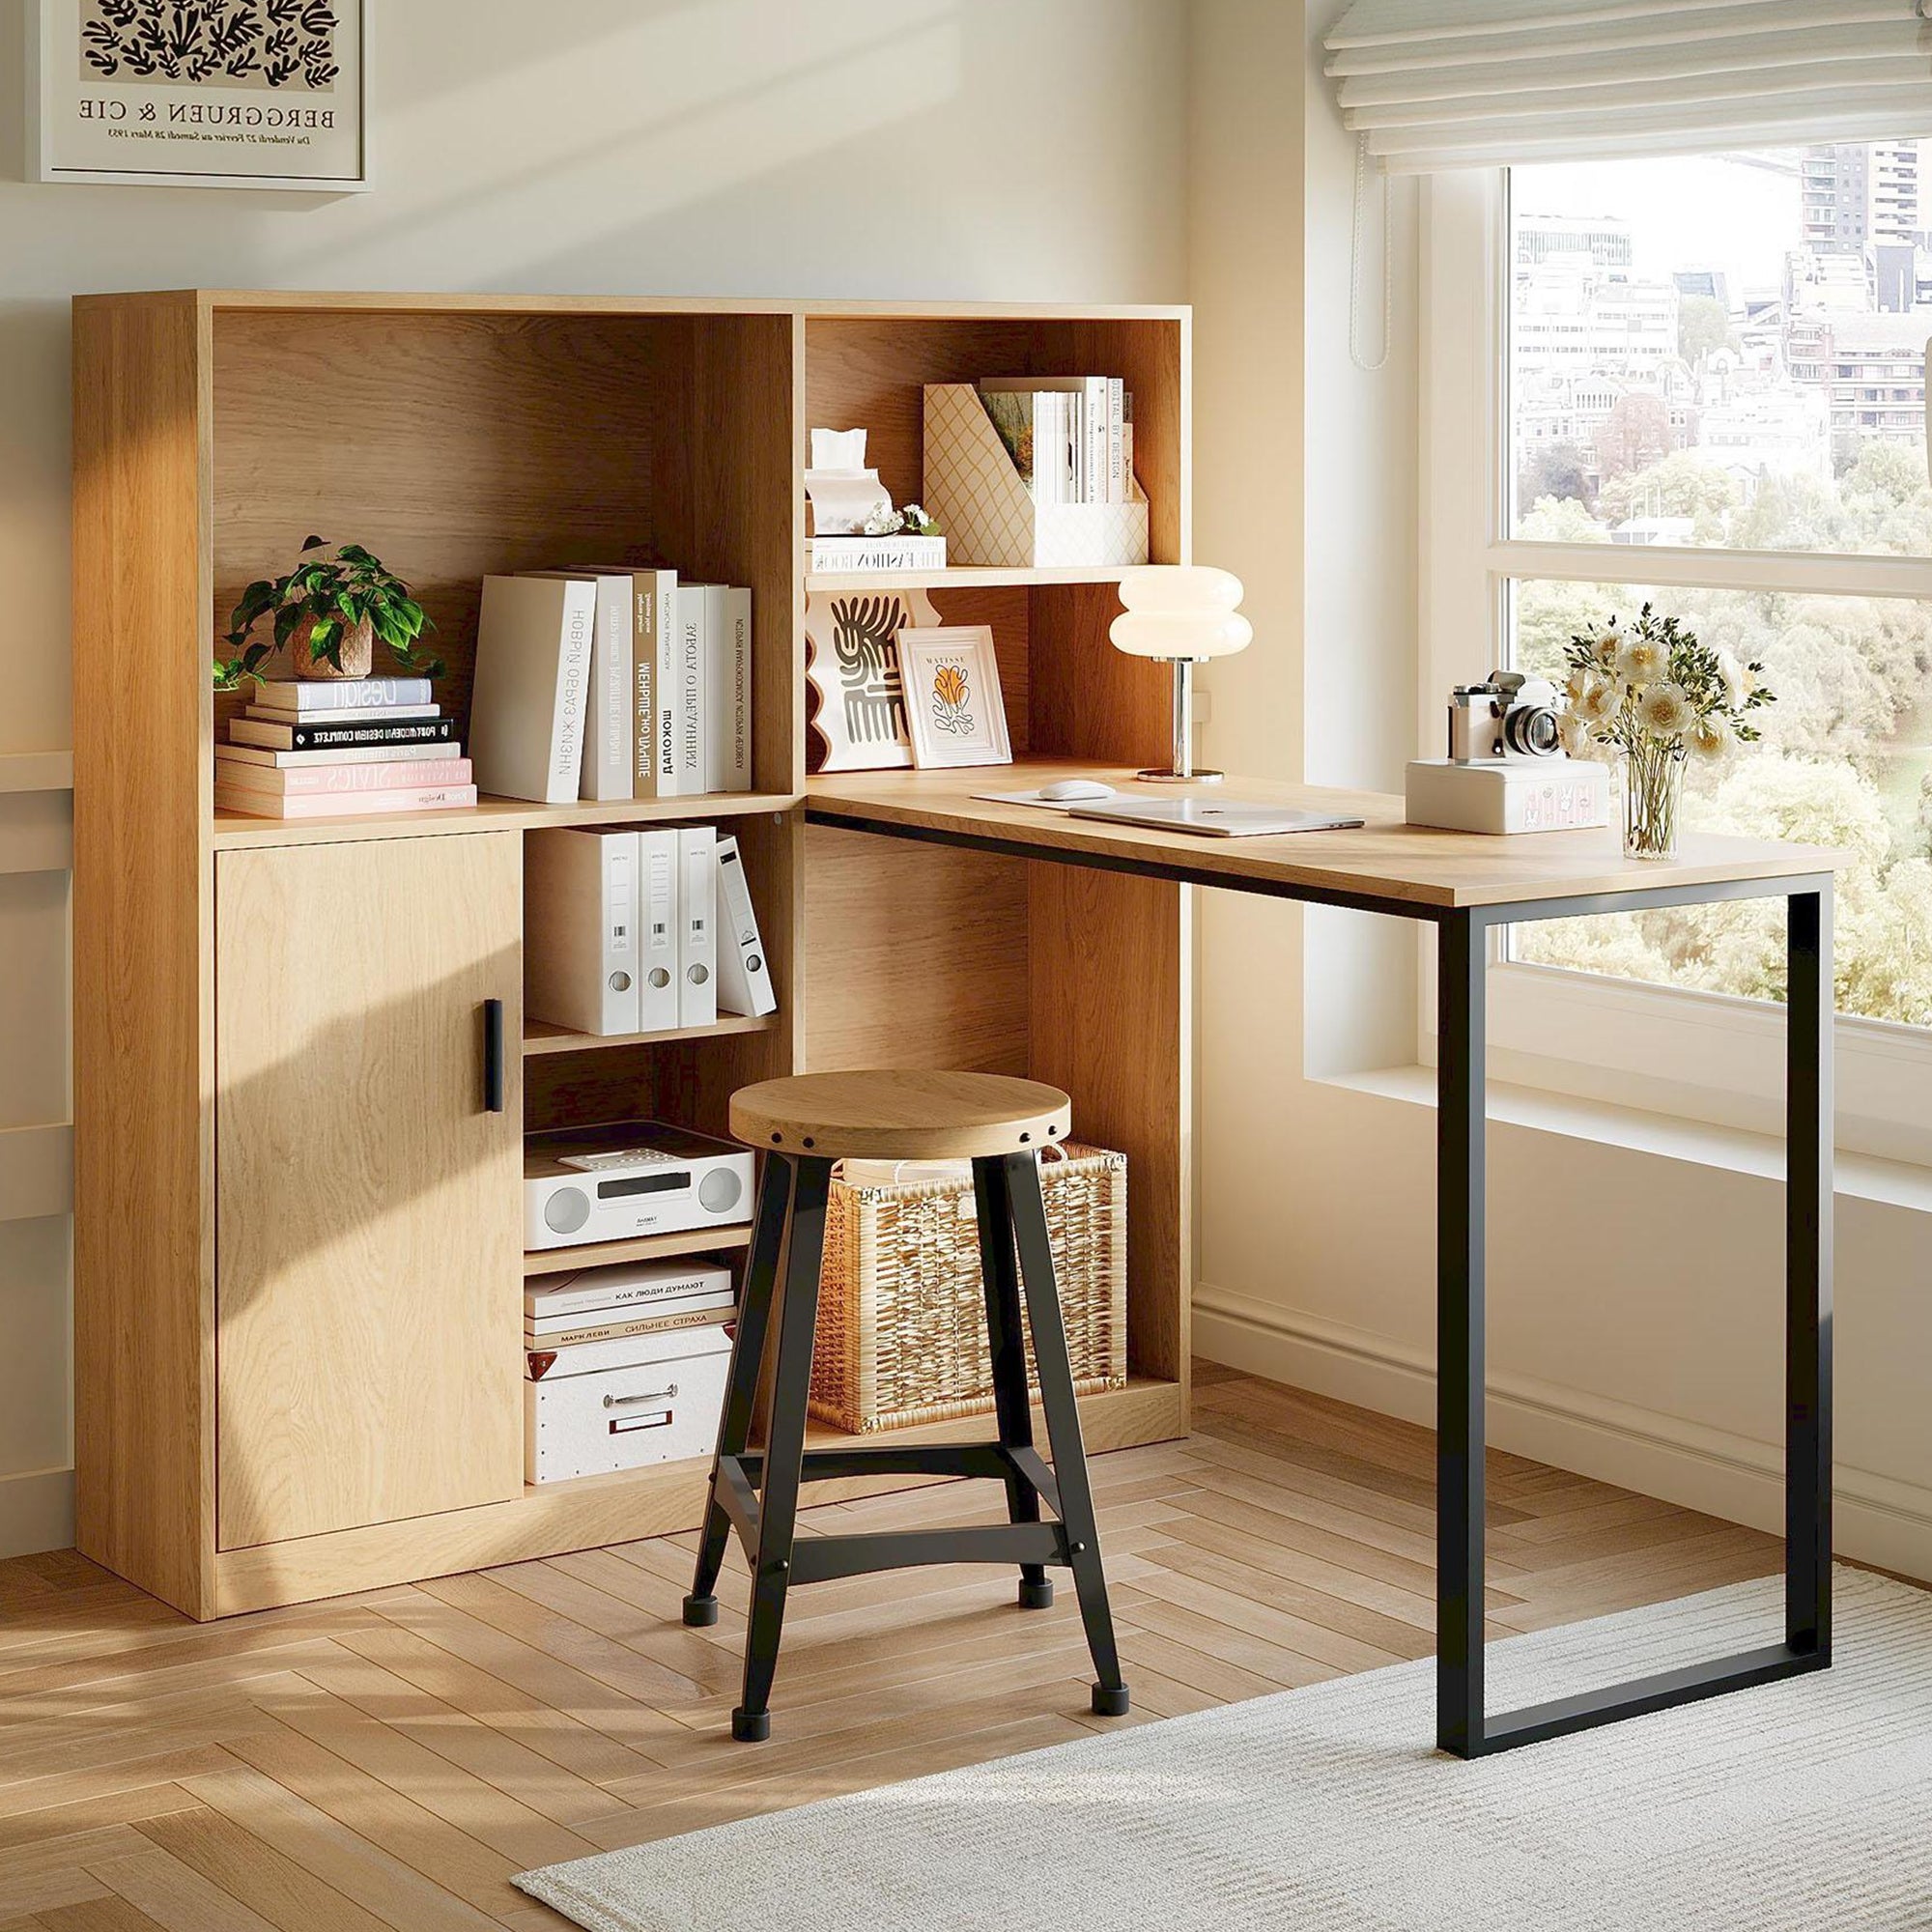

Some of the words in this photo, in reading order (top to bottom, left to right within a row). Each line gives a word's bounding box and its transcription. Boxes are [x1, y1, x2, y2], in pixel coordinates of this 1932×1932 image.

[1112, 442, 1121, 479] DESIGN
[614, 1291, 634, 1300] КАК
[635, 1288, 664, 1298] ЛЮДИ
[665, 1281, 705, 1294] ДУМАЮТ
[560, 1333, 584, 1343] МАРК
[584, 1329, 611, 1340] ЛЕВИ
[624, 1321, 670, 1333] СИЛЬНЕЕ
[672, 1315, 707, 1326] СТРАХА
